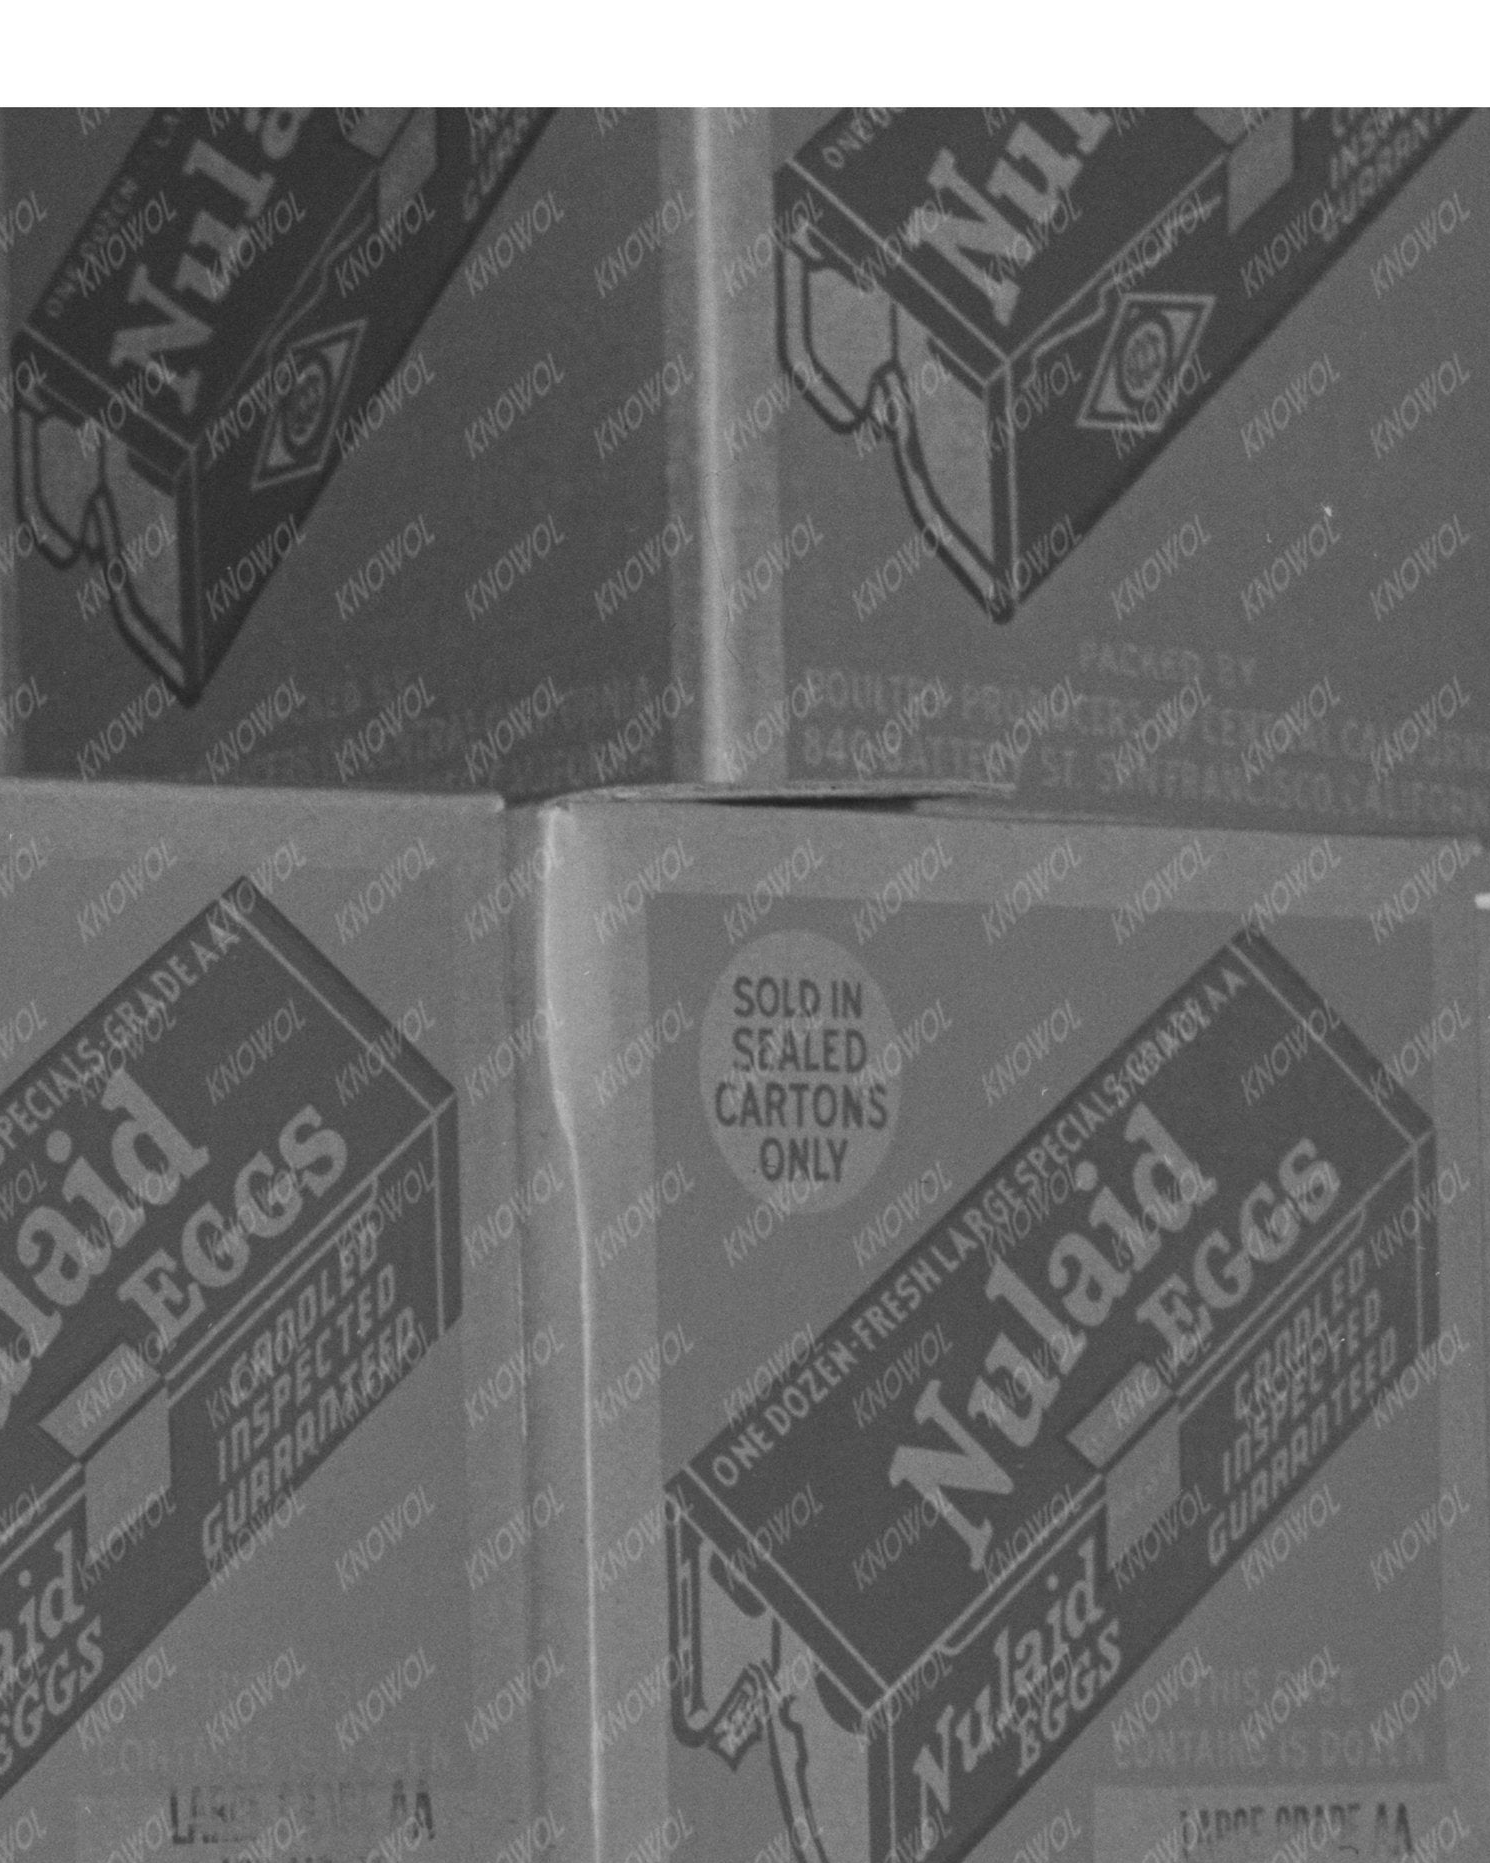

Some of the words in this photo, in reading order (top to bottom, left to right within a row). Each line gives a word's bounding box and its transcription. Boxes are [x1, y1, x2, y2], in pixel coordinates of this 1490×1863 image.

[102, 951, 197, 1050] GRADE
[193, 922, 240, 970] AA
[732, 1026, 868, 1074] SEALED
[733, 975, 821, 1018] SOLD
[831, 981, 863, 1019] IN
[714, 1081, 889, 1129] CARTONS
[759, 1137, 848, 1182] ONLY
[118, 1106, 347, 1350] EGGS
[1136, 1138, 1339, 1368] EGGS
[889, 1102, 1216, 1572] Nulaid
[914, 1539, 1104, 1860] Nulaid
[1013, 1622, 1124, 1777] EGGS
